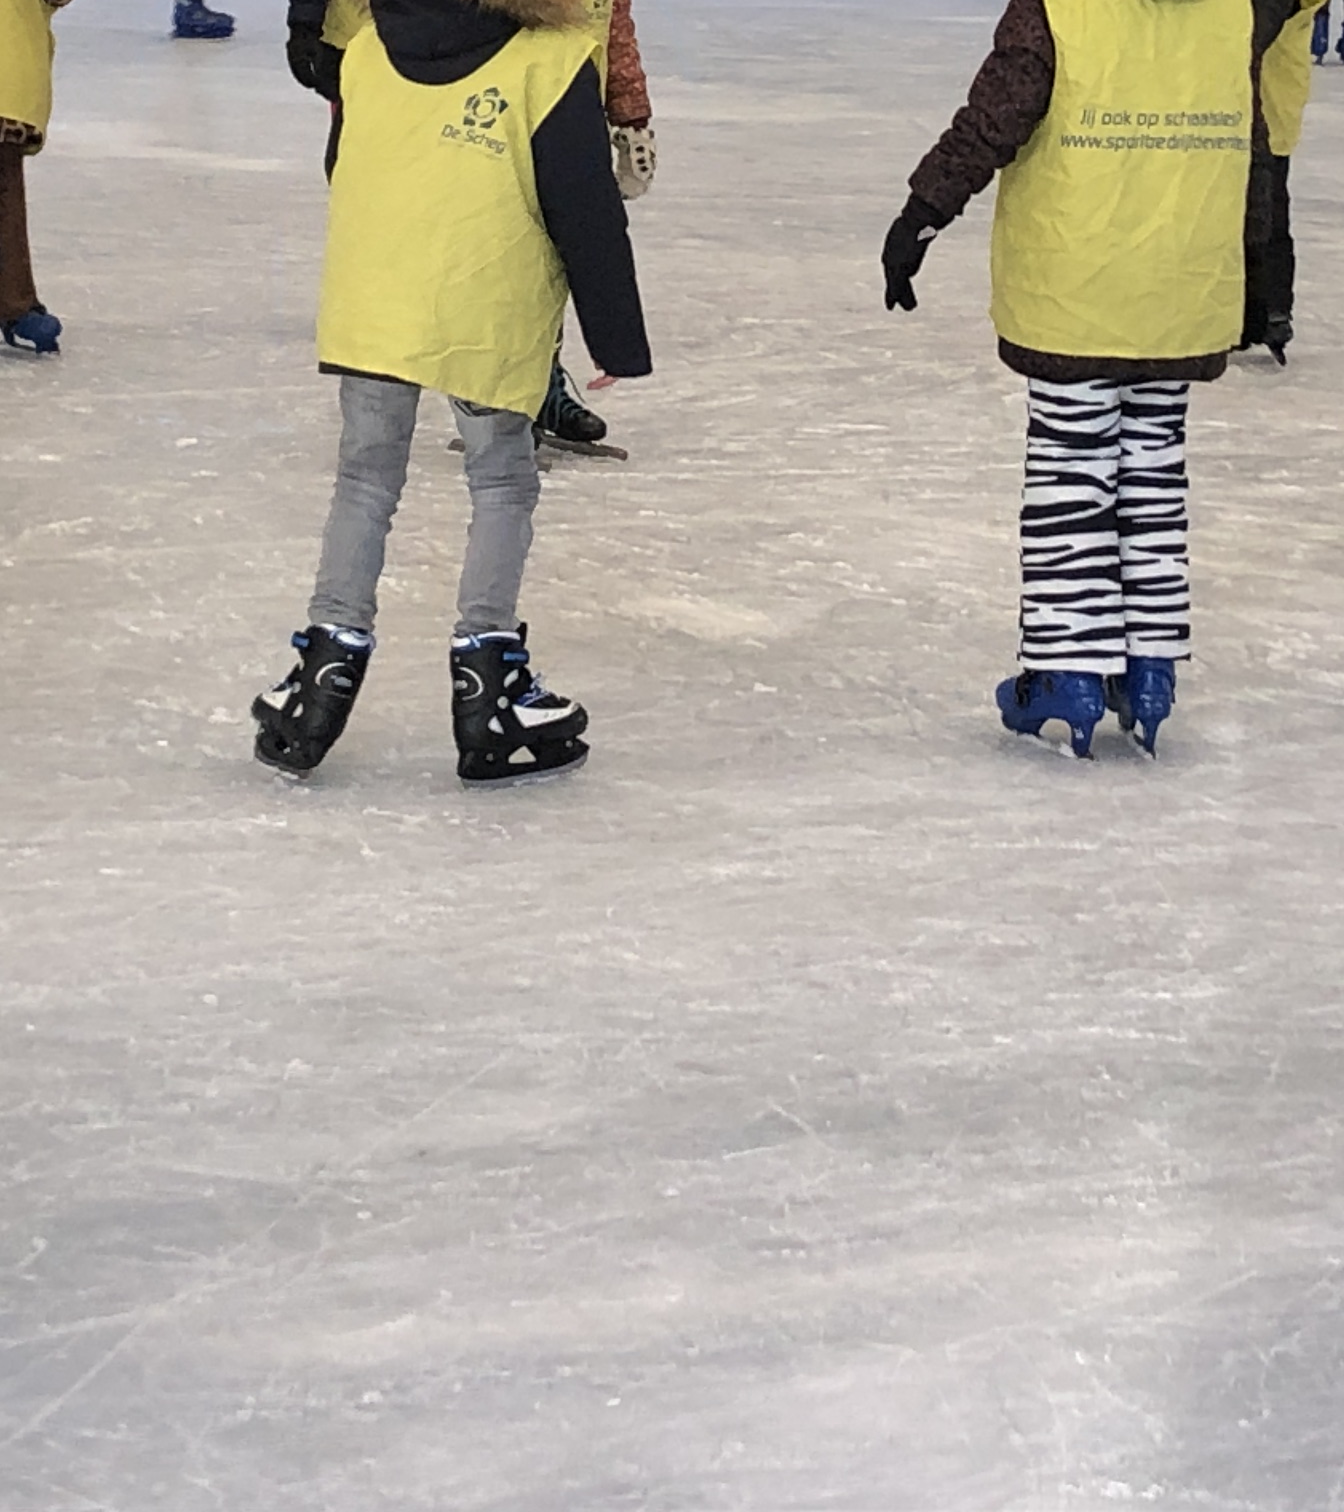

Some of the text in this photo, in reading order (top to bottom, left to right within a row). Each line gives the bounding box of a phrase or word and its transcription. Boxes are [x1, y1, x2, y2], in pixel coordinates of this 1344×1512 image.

[1101, 111, 1131, 126] ook
[1136, 113, 1159, 129] op
[441, 124, 505, 154] De Scheg
